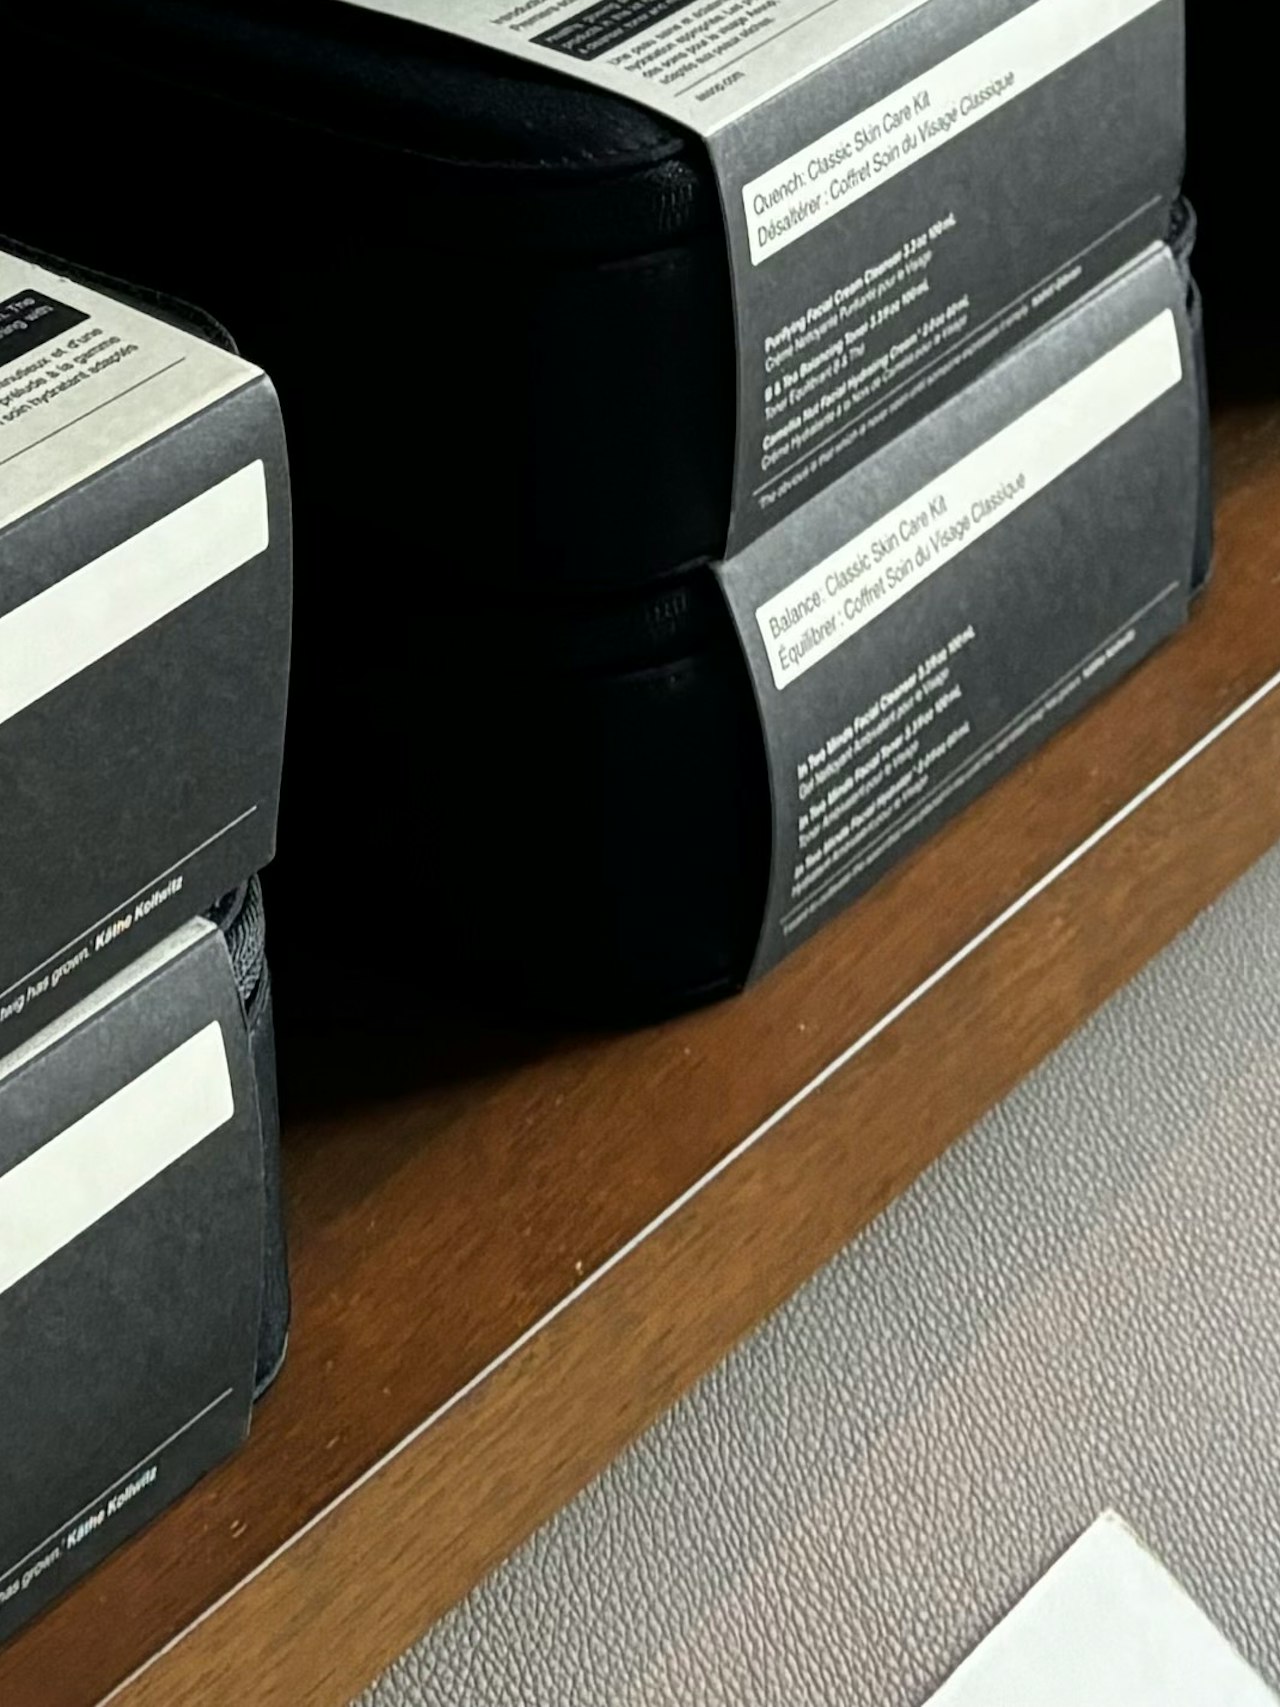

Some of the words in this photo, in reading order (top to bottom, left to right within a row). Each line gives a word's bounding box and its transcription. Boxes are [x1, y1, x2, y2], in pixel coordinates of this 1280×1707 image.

[753, 171, 806, 215] Quench:
[808, 142, 852, 181] Classic
[854, 122, 882, 152] Skin
[882, 104, 912, 134] Care
[912, 90, 932, 114] Kit
[872, 142, 900, 173] Soin
[902, 133, 918, 155] du
[917, 108, 958, 143] Visage
[768, 588, 826, 639] Balance:
[825, 552, 872, 597] Classic
[871, 533, 900, 564] Skin
[899, 512, 929, 542] Care
[929, 494, 948, 522] Kit
[843, 576, 886, 620] Coffret
[886, 557, 914, 589] Soin
[915, 545, 931, 566] du
[929, 514, 970, 554] Visage
[971, 472, 1026, 523] Classique
